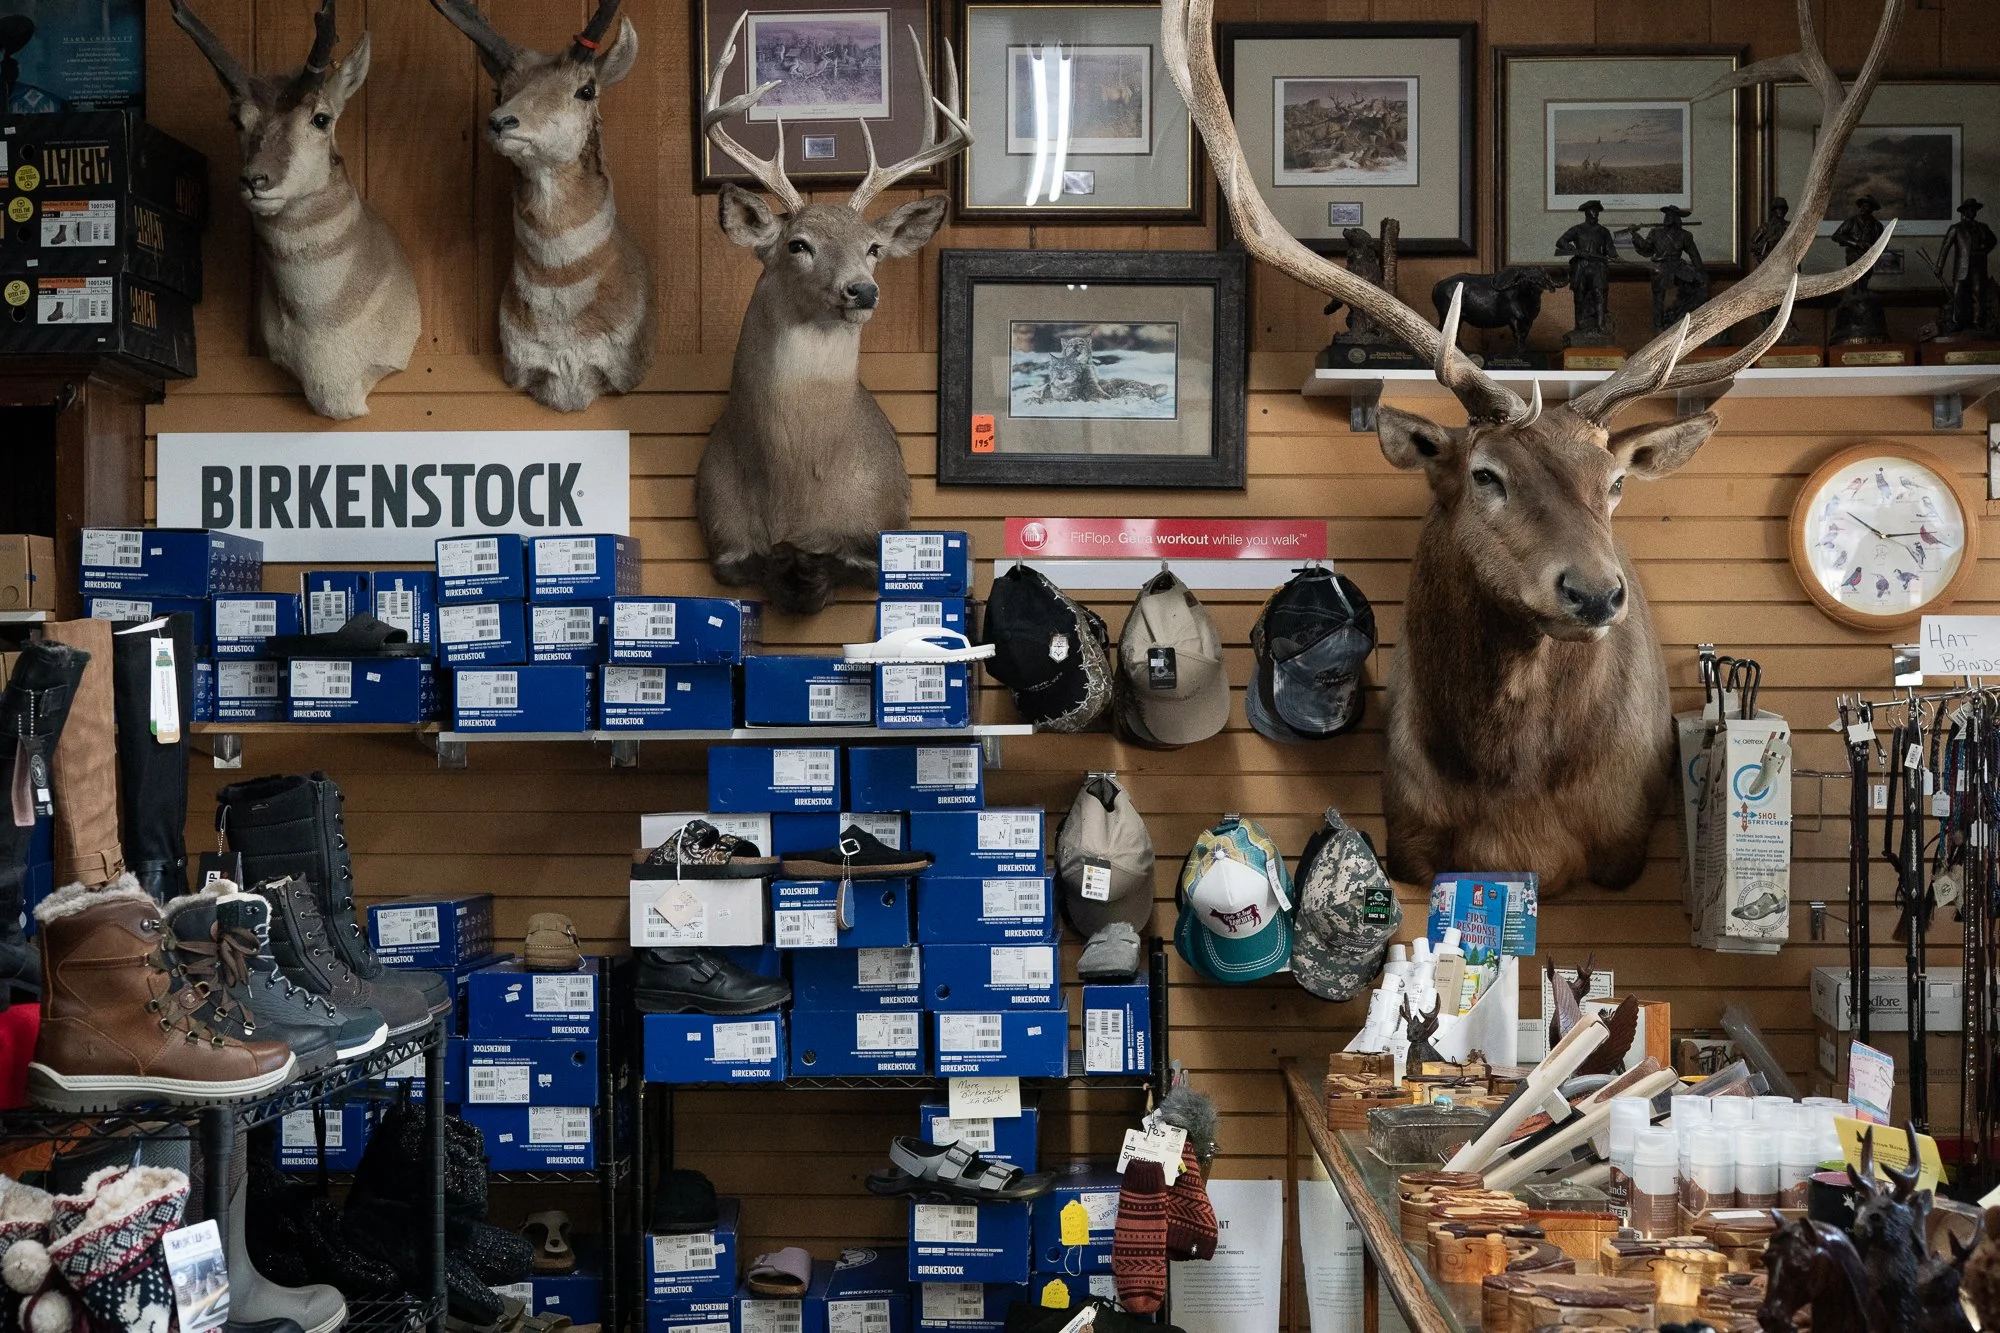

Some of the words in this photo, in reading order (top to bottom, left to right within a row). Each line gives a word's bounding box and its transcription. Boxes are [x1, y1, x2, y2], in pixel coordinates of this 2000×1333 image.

[43, 146, 112, 188] ARIAT
[133, 204, 165, 251] ARIAT
[130, 285, 157, 330] ARIAT
[1156, 533, 1209, 545] workout
[1212, 533, 1243, 545] while
[1245, 537, 1269, 549] you
[84, 581, 122, 590] BIRKENSTOCK
[884, 582, 924, 590] BIRKENSTOCK
[445, 587, 483, 597] BIRKENSTOCK
[535, 586, 575, 595] BIRKENSTOCK
[1928, 623, 1978, 650] HAT
[217, 645, 255, 653] BIRKENSTOCK
[448, 652, 486, 661] BIRKENSTOCK
[534, 652, 573, 661] BIRKENSTOCK
[614, 650, 652, 658] BIRKENSTOCK
[219, 709, 256, 717] BIRKENSTOCK
[293, 710, 331, 718] BIRKENSTOCK
[605, 717, 644, 725] BIRKENSTOCK
[884, 714, 923, 722] BIRKENSTOCK
[458, 719, 497, 727] BIRKENSTOCK
[794, 798, 833, 806] BIRKENSTOCK
[937, 796, 976, 804] BIRKENSTOCK
[1758, 812, 1777, 820] SHOE
[997, 864, 1036, 872] BIRKENSTOCK
[780, 887, 819, 895] BIRKENSTOCK
[1465, 912, 1488, 923] FIRST
[1457, 921, 1497, 936] RESPONSE
[1004, 929, 1044, 937] BIRKENSTOCK
[880, 996, 918, 1004] BIRKENSTOCK
[1011, 995, 1050, 1003] BIRKENSTOCK
[1844, 995, 1900, 1007] Wdlore
[551, 1026, 590, 1034] BIRKENSTOCK
[473, 1044, 511, 1053] BIRKENSTOCK
[877, 1063, 916, 1071] BIRKENSTOCK
[940, 1064, 979, 1072] BIRKENSTOCK
[732, 1069, 771, 1077] BIRKENSTOCK
[957, 1079, 980, 1089] More
[546, 1156, 585, 1164] BIRKENSTOCK
[918, 1265, 965, 1275] BIRKENSTOCK
[654, 1286, 693, 1295] BIRKENSTOCK
[690, 1303, 729, 1311] BIRKENSTOCK
